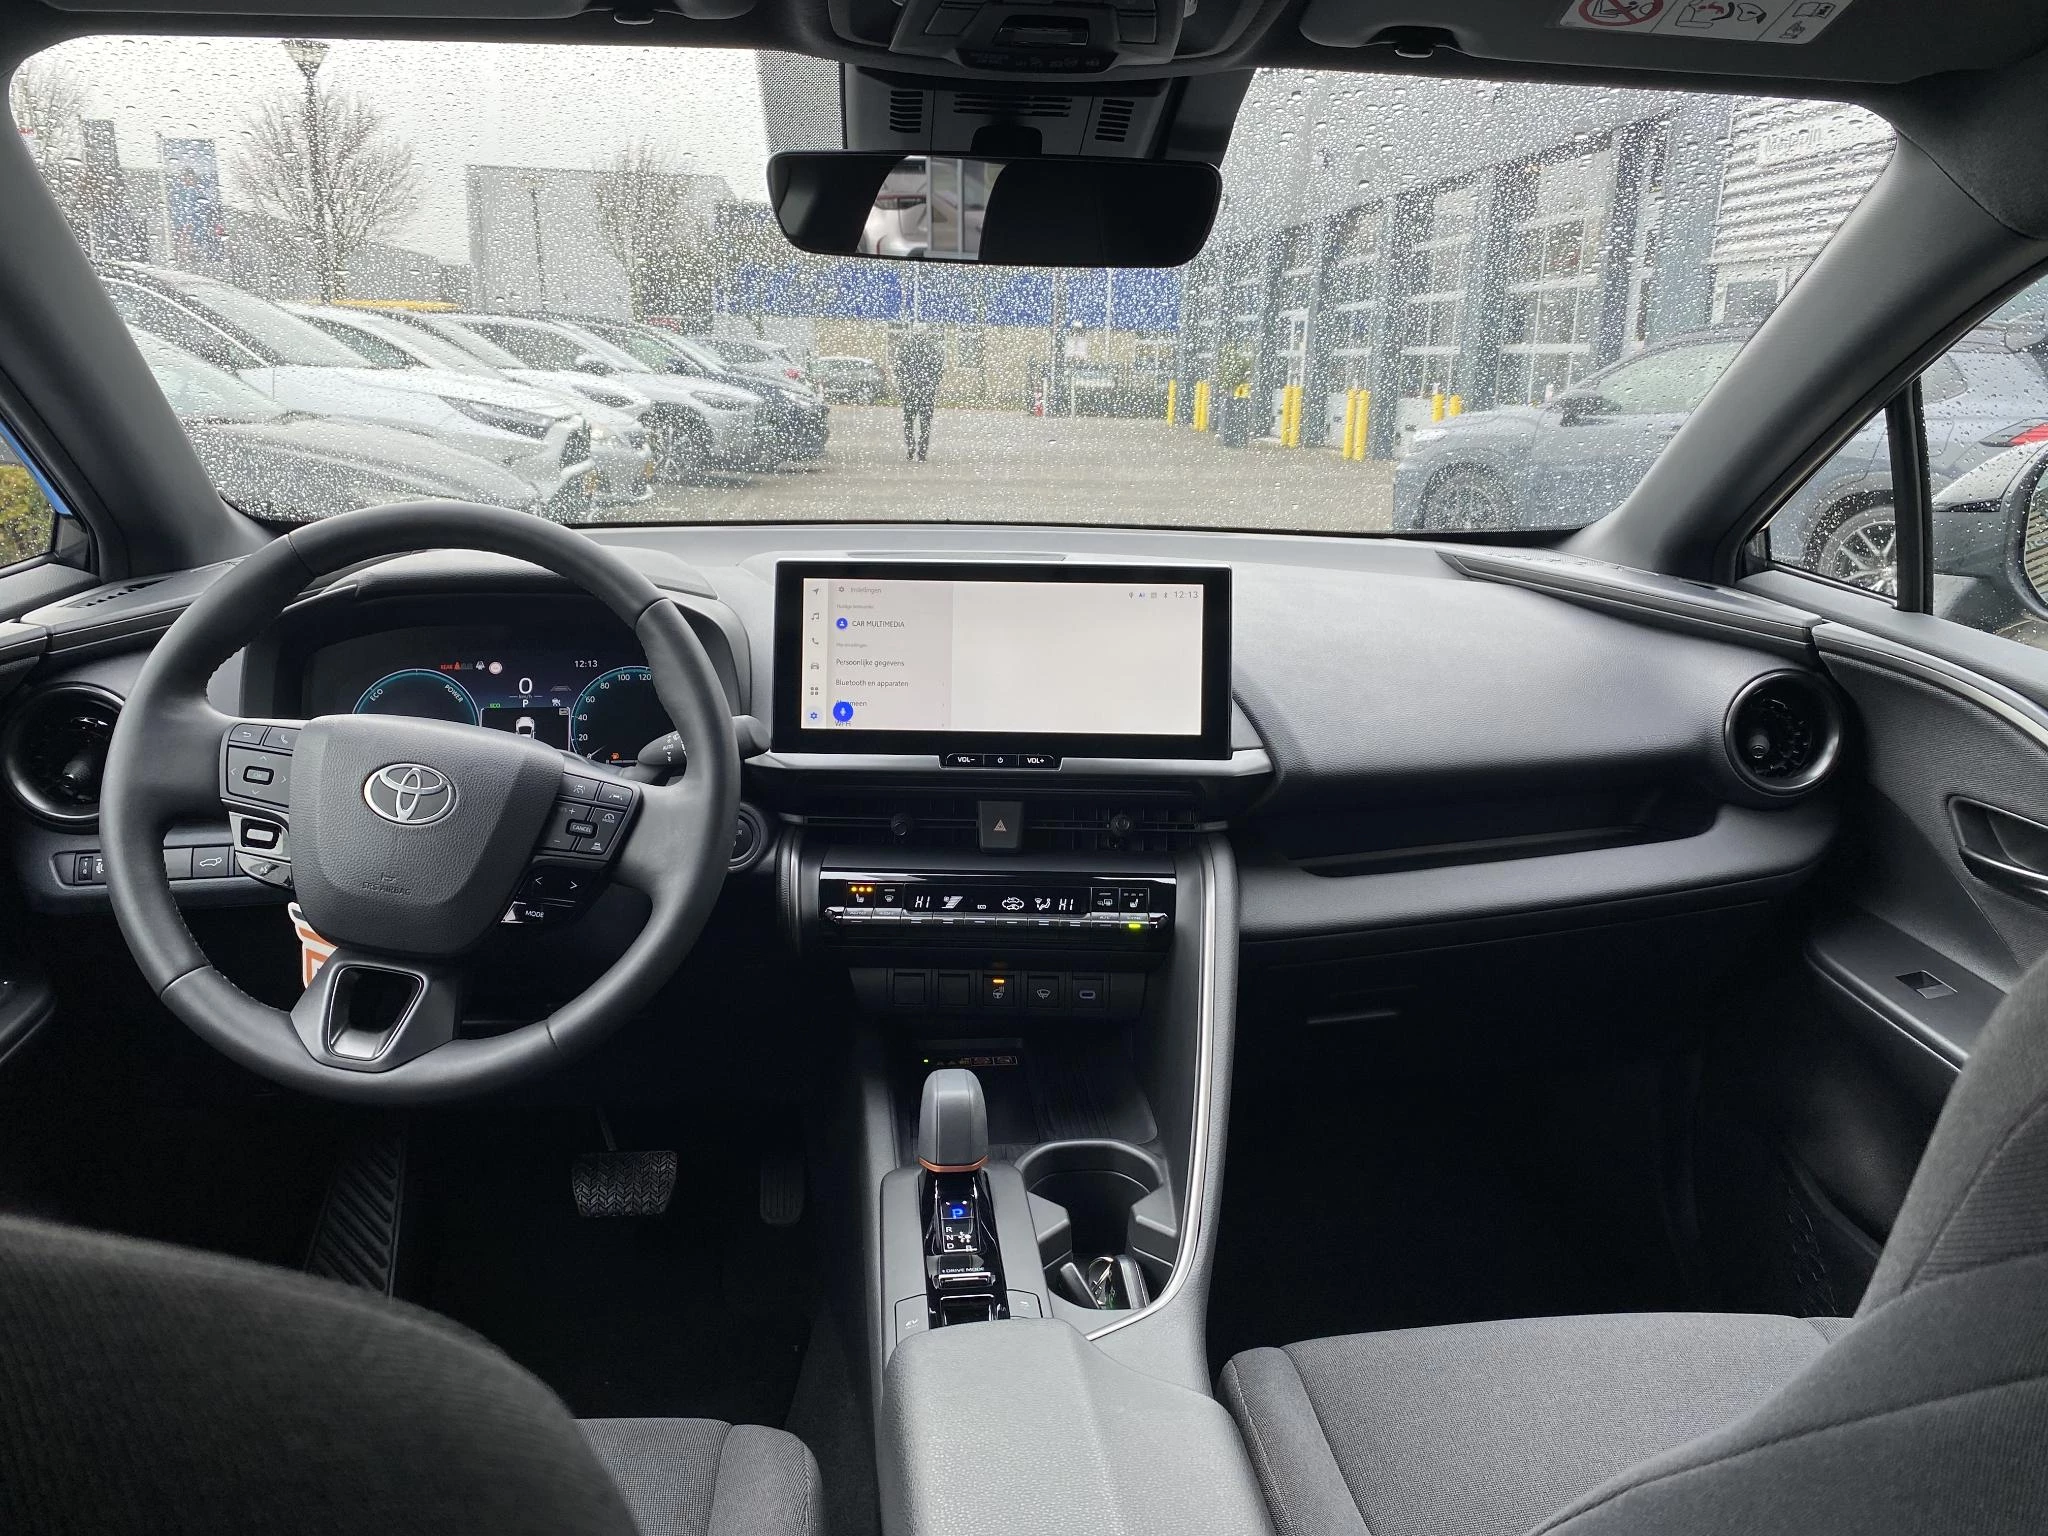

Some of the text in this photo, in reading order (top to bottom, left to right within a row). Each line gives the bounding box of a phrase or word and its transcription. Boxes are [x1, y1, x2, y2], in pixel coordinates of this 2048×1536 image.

[1174, 590, 1199, 599] 12:13
[866, 620, 905, 628] MULTIMEDIA
[574, 660, 598, 668] 12:13
[835, 658, 905, 667] Persoonlijke gegevens
[518, 677, 533, 694] 0
[600, 682, 610, 690] 80
[835, 679, 867, 687] Bluetooth
[876, 680, 909, 688] apparaten
[369, 688, 384, 702] ECO
[444, 684, 464, 703] POWER
[522, 699, 529, 708] P
[585, 695, 596, 703] 60
[577, 713, 588, 721] 40
[578, 733, 588, 741] 20
[662, 743, 674, 751] AUTO
[572, 824, 592, 833] CANCEL
[525, 910, 544, 918] MODE
[952, 1208, 963, 1219] P
